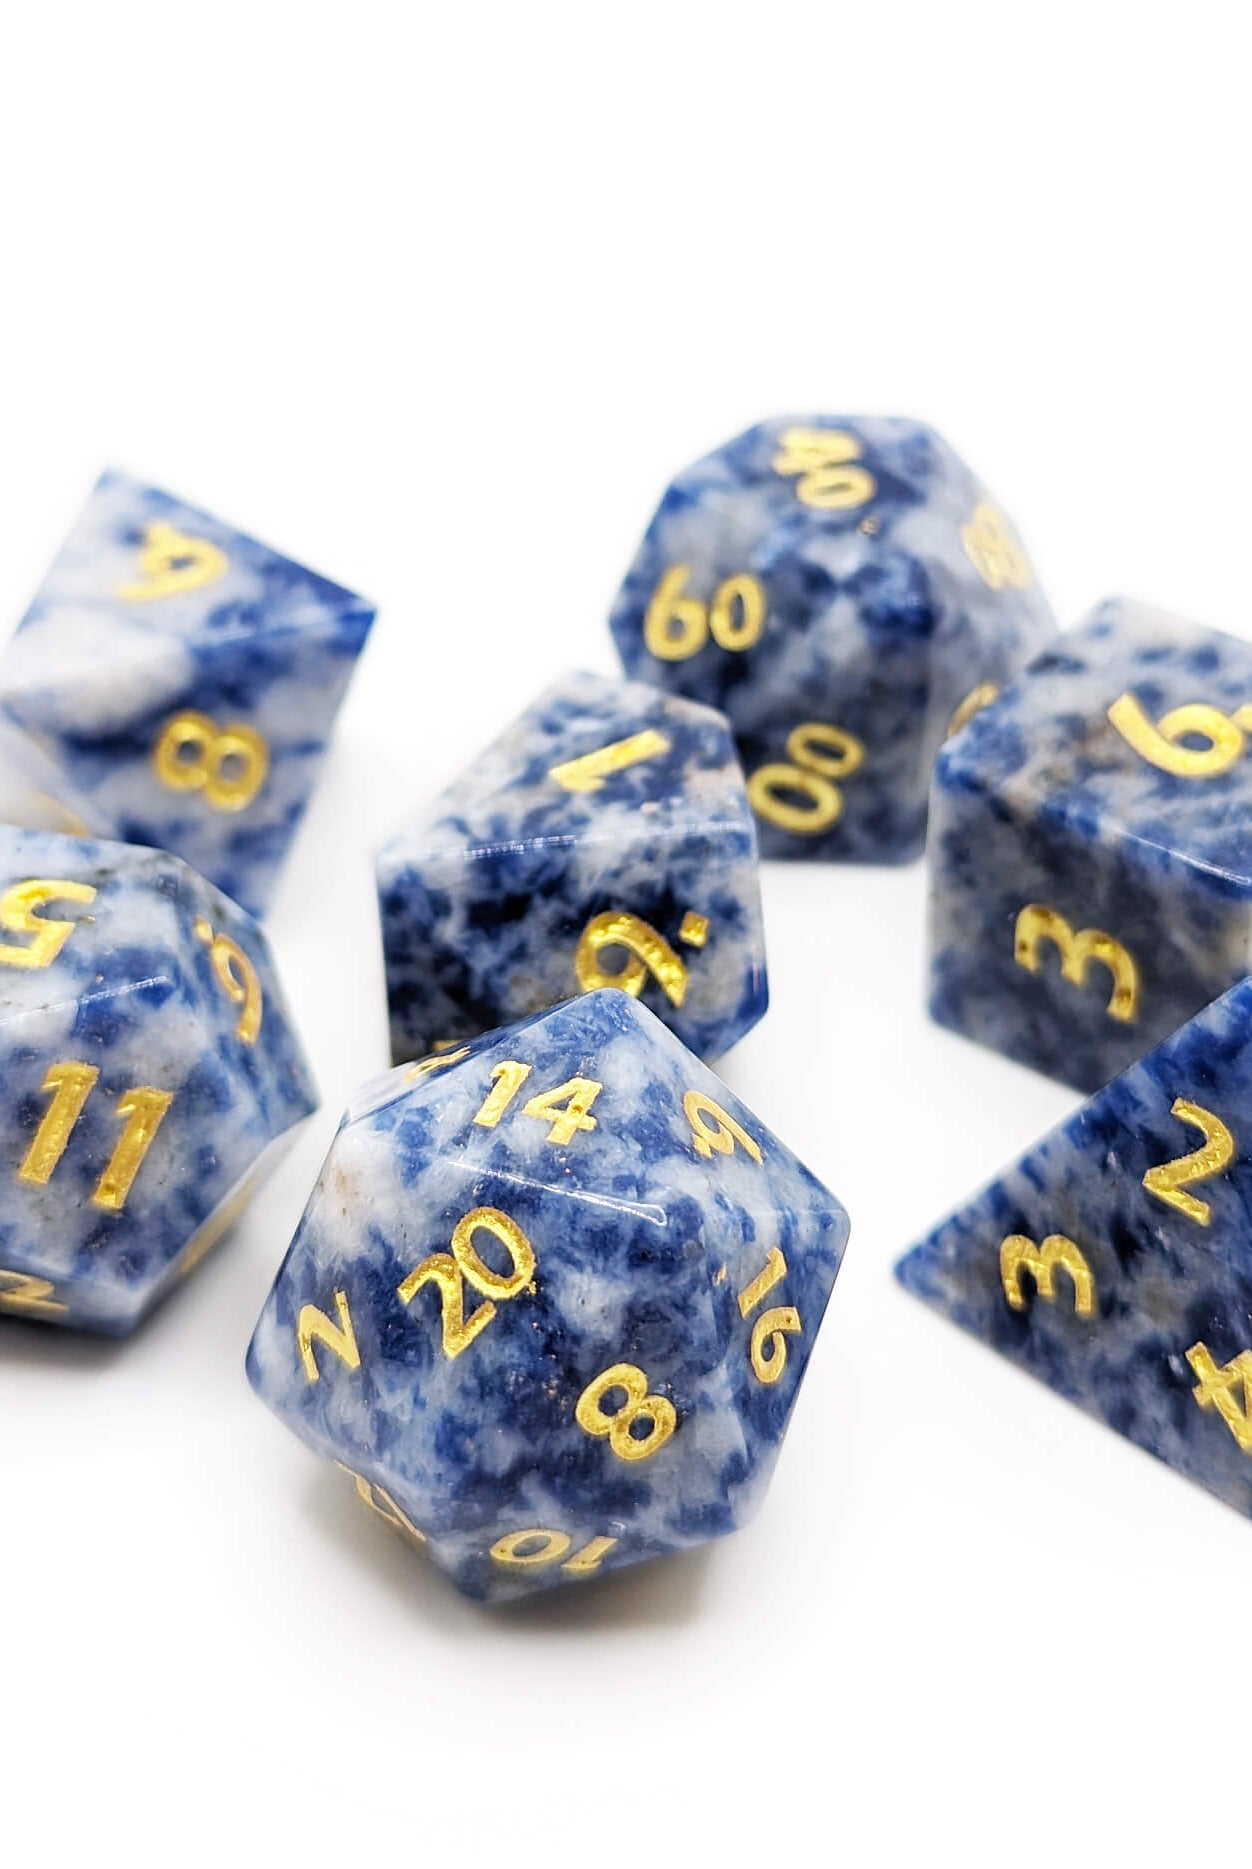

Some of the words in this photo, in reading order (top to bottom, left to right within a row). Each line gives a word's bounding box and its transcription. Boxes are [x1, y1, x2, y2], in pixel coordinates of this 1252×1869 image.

[644, 563, 766, 661] 60
[153, 711, 268, 813] 8
[549, 729, 670, 793] 1
[745, 722, 864, 833] 00
[0, 878, 97, 969] 5
[1014, 905, 1142, 1023] 3
[17, 1060, 174, 1211] 11
[473, 1060, 603, 1146] 14
[1143, 1097, 1236, 1226] 2
[397, 1206, 537, 1360] 20
[737, 1247, 802, 1385] 16
[1000, 1233, 1096, 1318] 3
[296, 1290, 361, 1383] 2
[574, 1362, 678, 1463] 8
[489, 1528, 617, 1573] 10
